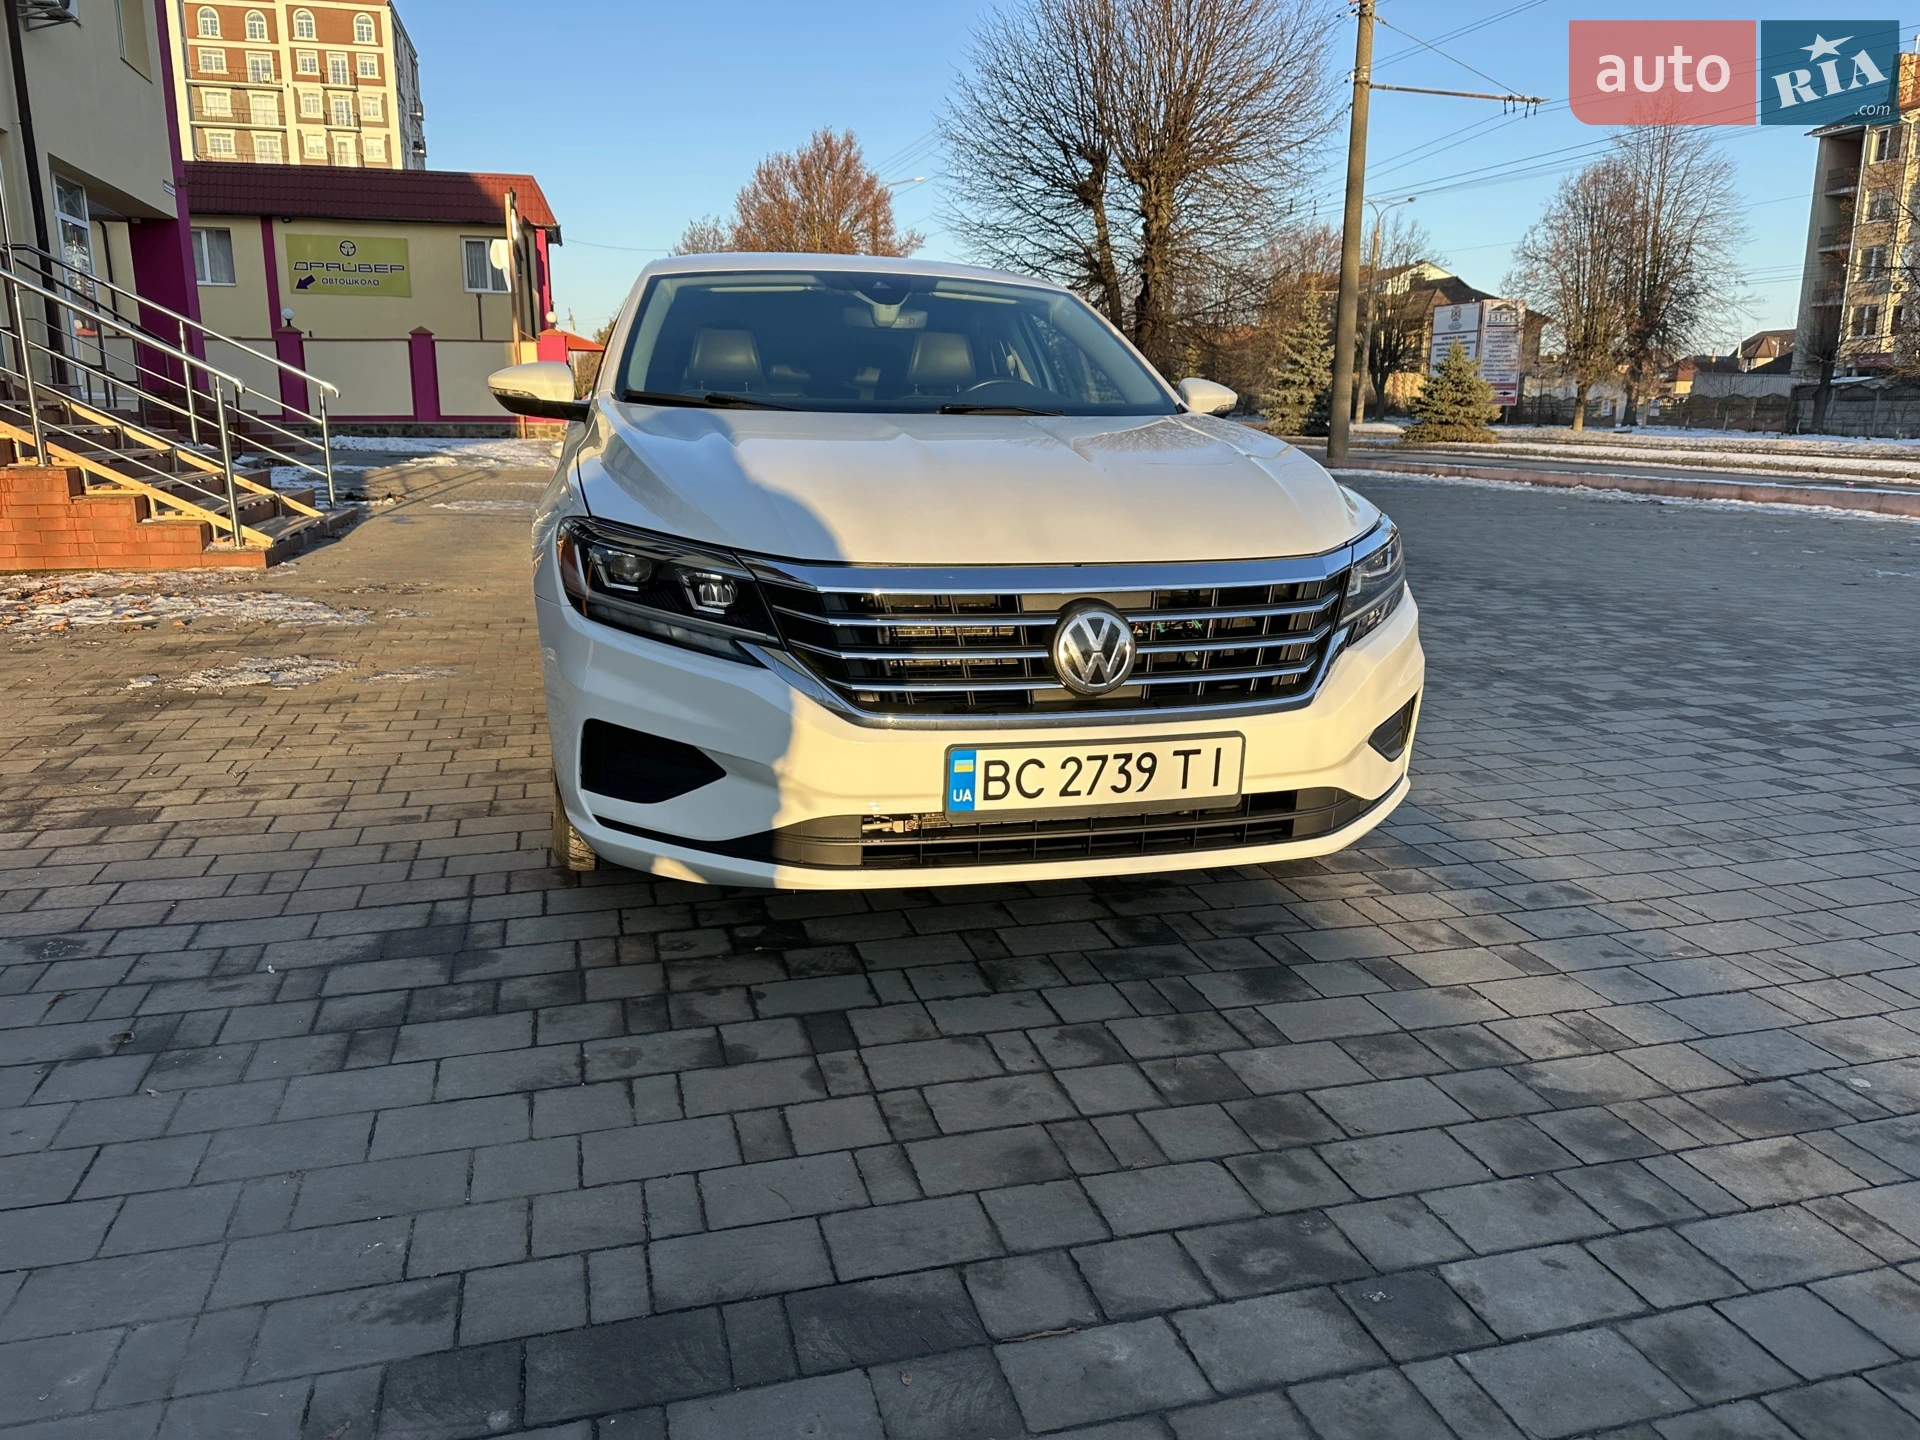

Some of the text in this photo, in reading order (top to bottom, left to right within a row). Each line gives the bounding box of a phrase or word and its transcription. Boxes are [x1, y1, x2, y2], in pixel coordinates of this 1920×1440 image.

[293, 261, 405, 274] ДРАЙВЕР
[321, 277, 380, 286] автошкола
[982, 758, 1046, 801] BC
[1058, 751, 1158, 797] 2739
[952, 789, 973, 802] UA
